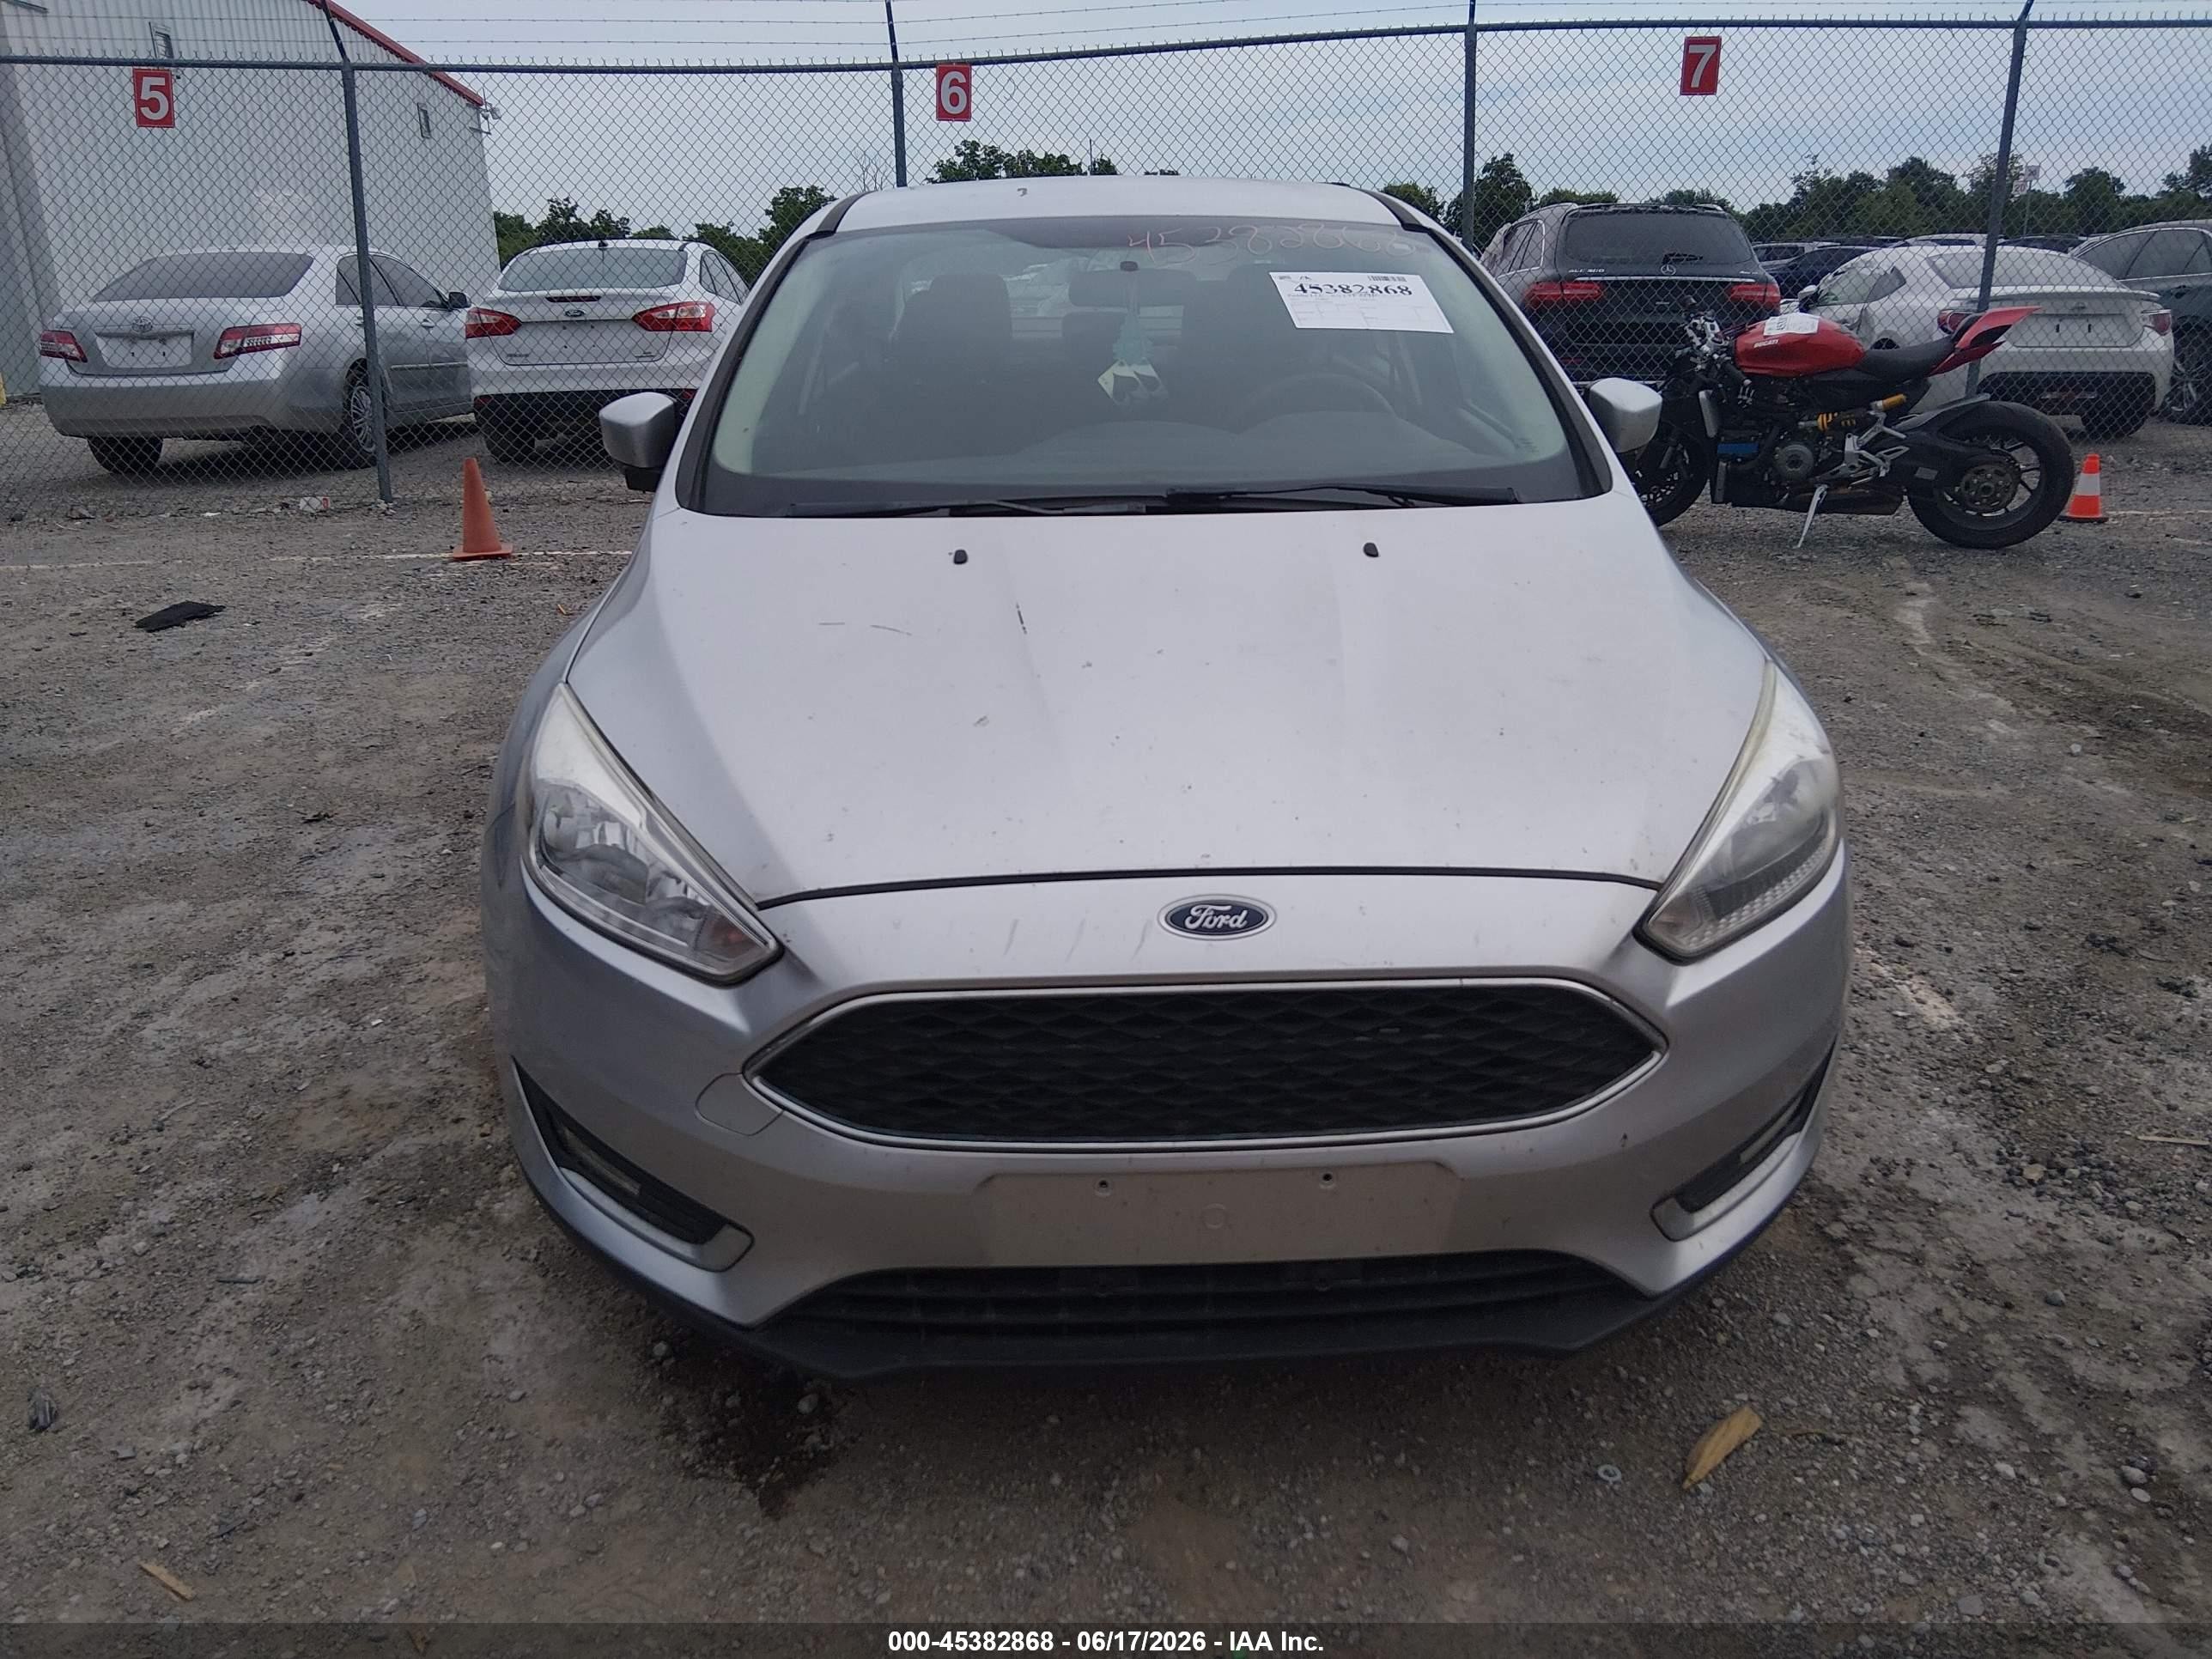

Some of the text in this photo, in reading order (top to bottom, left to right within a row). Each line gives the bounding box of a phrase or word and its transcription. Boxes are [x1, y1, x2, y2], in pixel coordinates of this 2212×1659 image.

[1688, 44, 1717, 88] 7
[140, 76, 169, 120] 5
[940, 70, 967, 114] 6
[1294, 282, 1413, 295] 45382868
[1185, 904, 1249, 929] Ford
